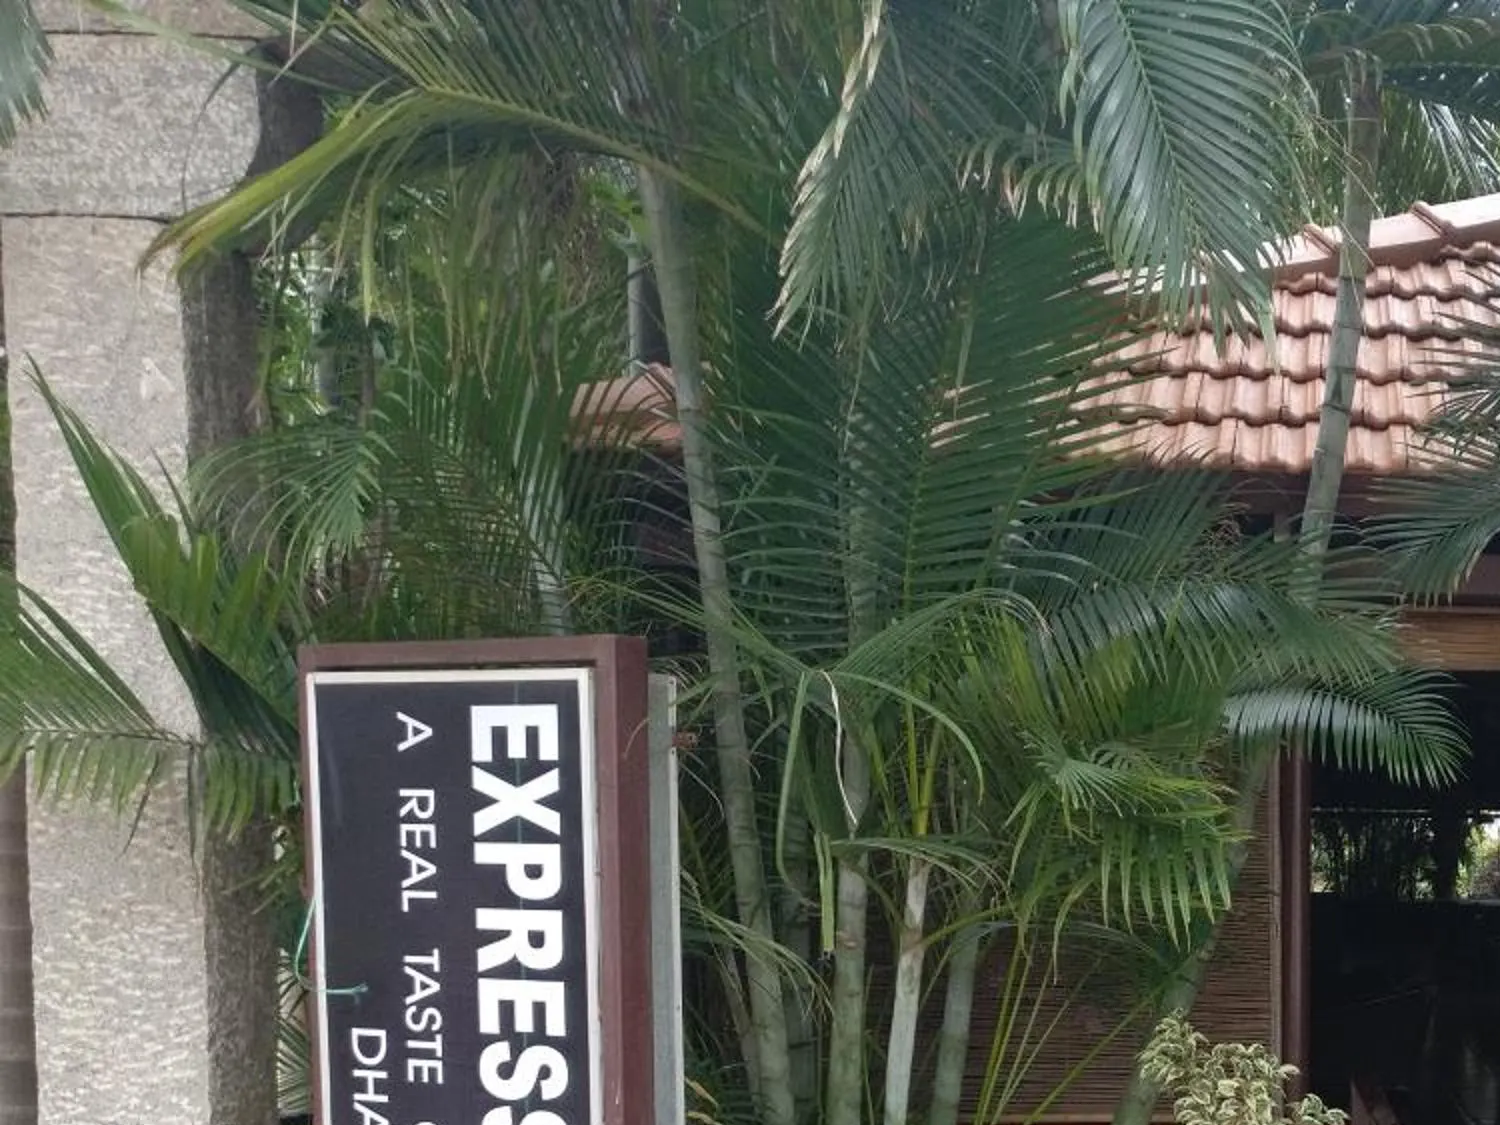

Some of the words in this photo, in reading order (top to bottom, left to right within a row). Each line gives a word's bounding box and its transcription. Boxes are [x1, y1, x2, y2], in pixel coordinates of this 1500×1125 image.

[396, 711, 433, 752] A
[399, 788, 438, 913] REAL
[403, 948, 444, 1085] TASTE
